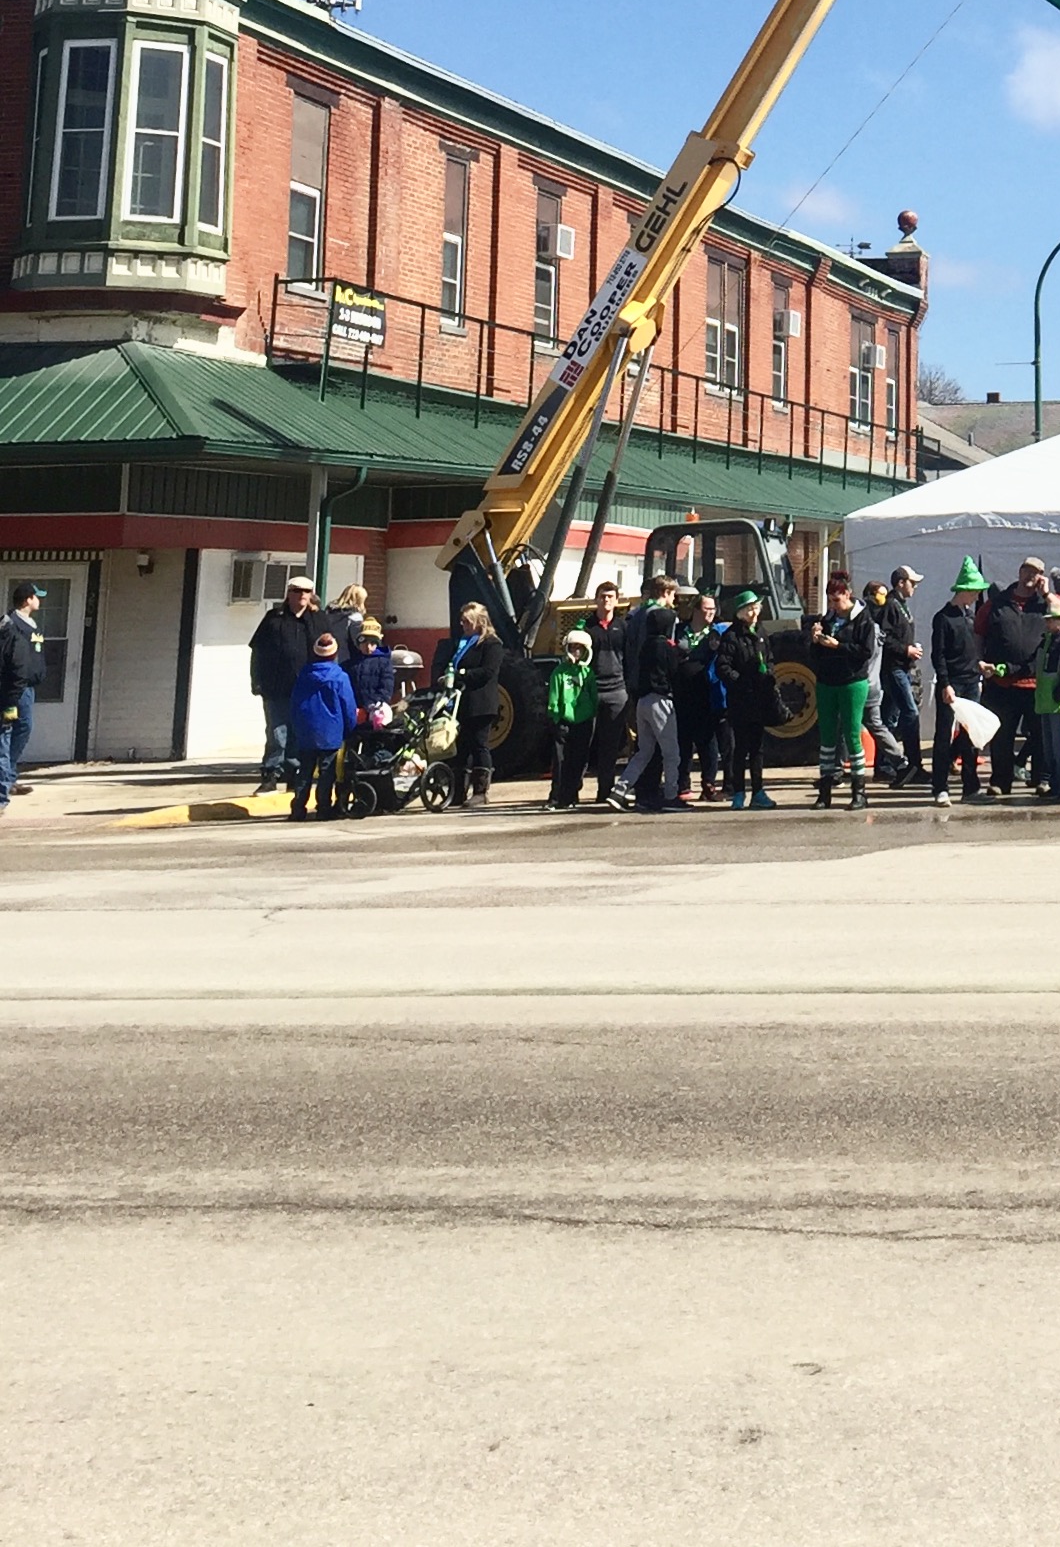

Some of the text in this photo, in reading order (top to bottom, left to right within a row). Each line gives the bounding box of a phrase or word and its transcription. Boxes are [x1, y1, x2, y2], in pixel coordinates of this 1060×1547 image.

[635, 181, 688, 253] GEHL
[561, 308, 598, 361] DAN
[577, 262, 637, 357] COOPER
[595, 269, 638, 342] BUILDERS
[511, 415, 549, 471] RS8-44
